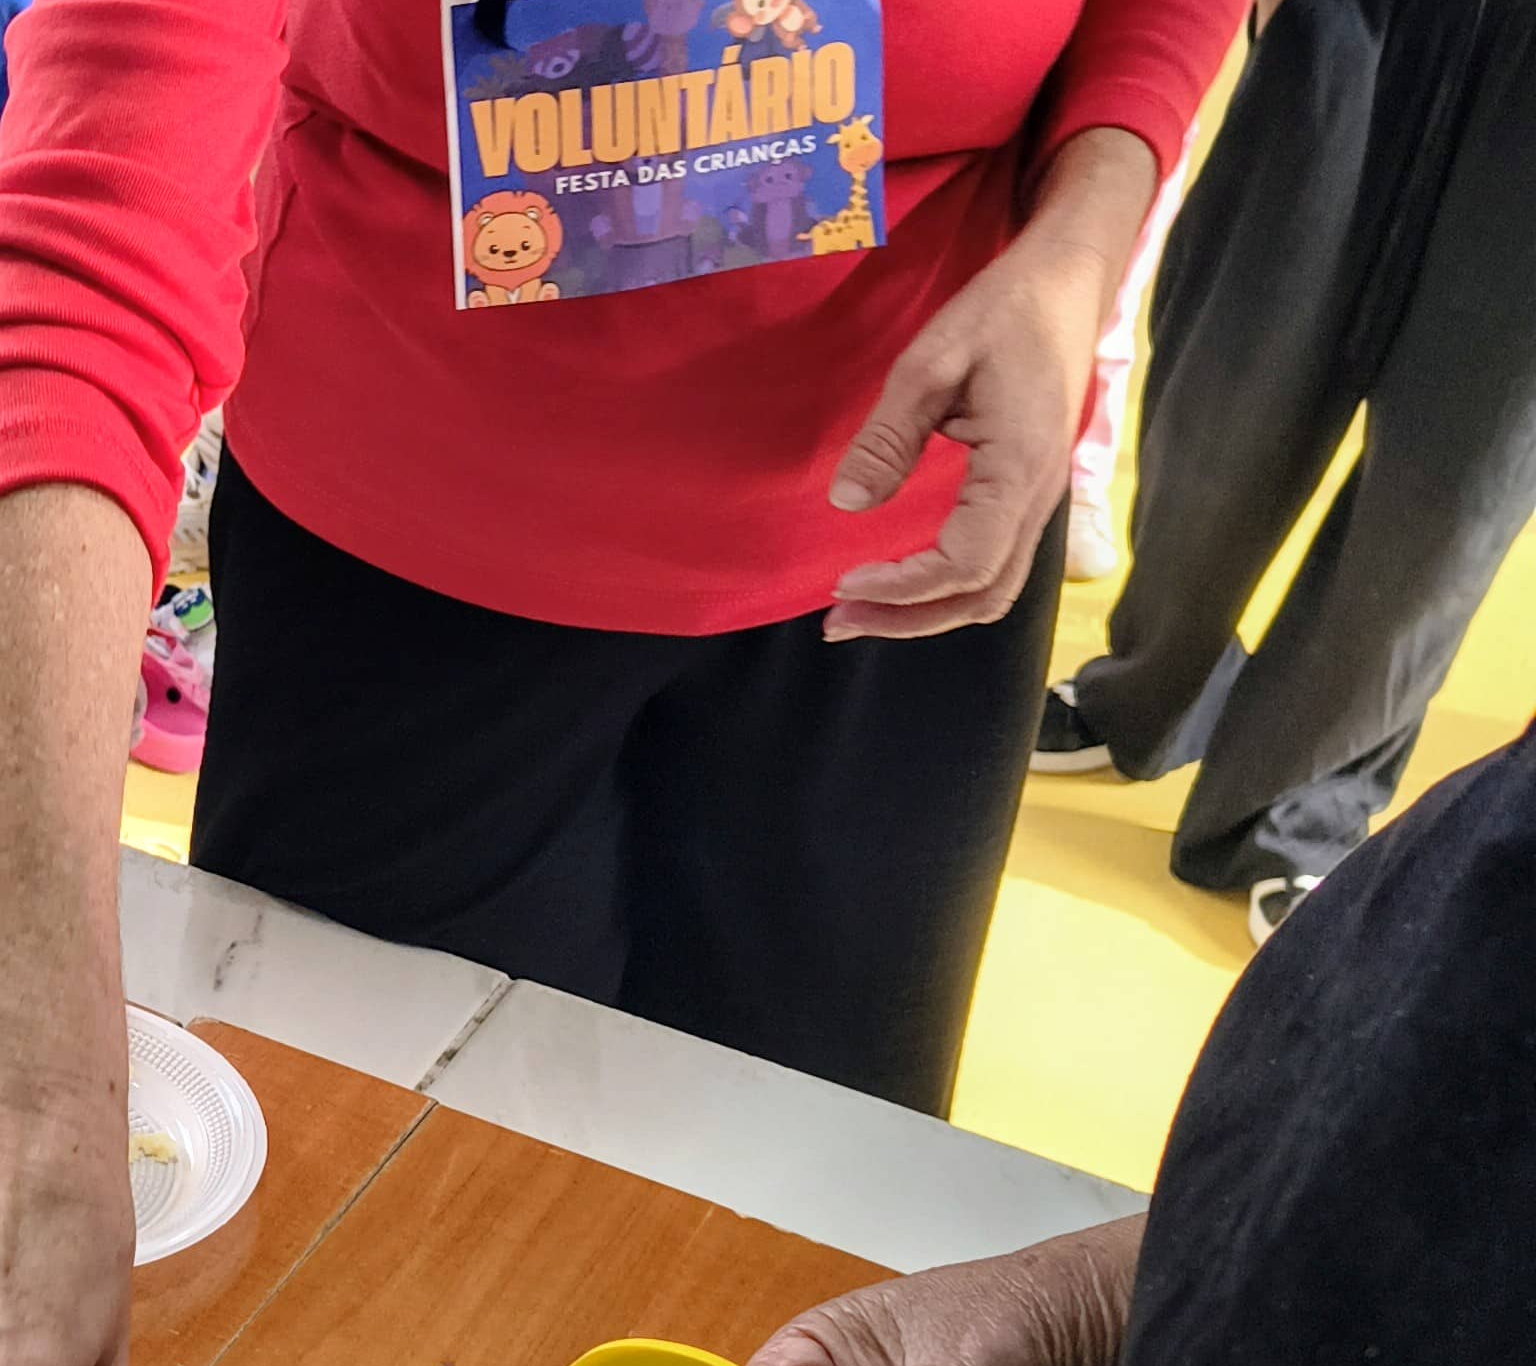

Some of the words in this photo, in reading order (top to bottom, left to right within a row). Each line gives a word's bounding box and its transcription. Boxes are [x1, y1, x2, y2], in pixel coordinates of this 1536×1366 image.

[470, 42, 856, 177] VOLUNTÁRIO
[555, 169, 631, 195] FESTA
[637, 160, 687, 184] DAS
[693, 135, 817, 174] CRIANÇAS
